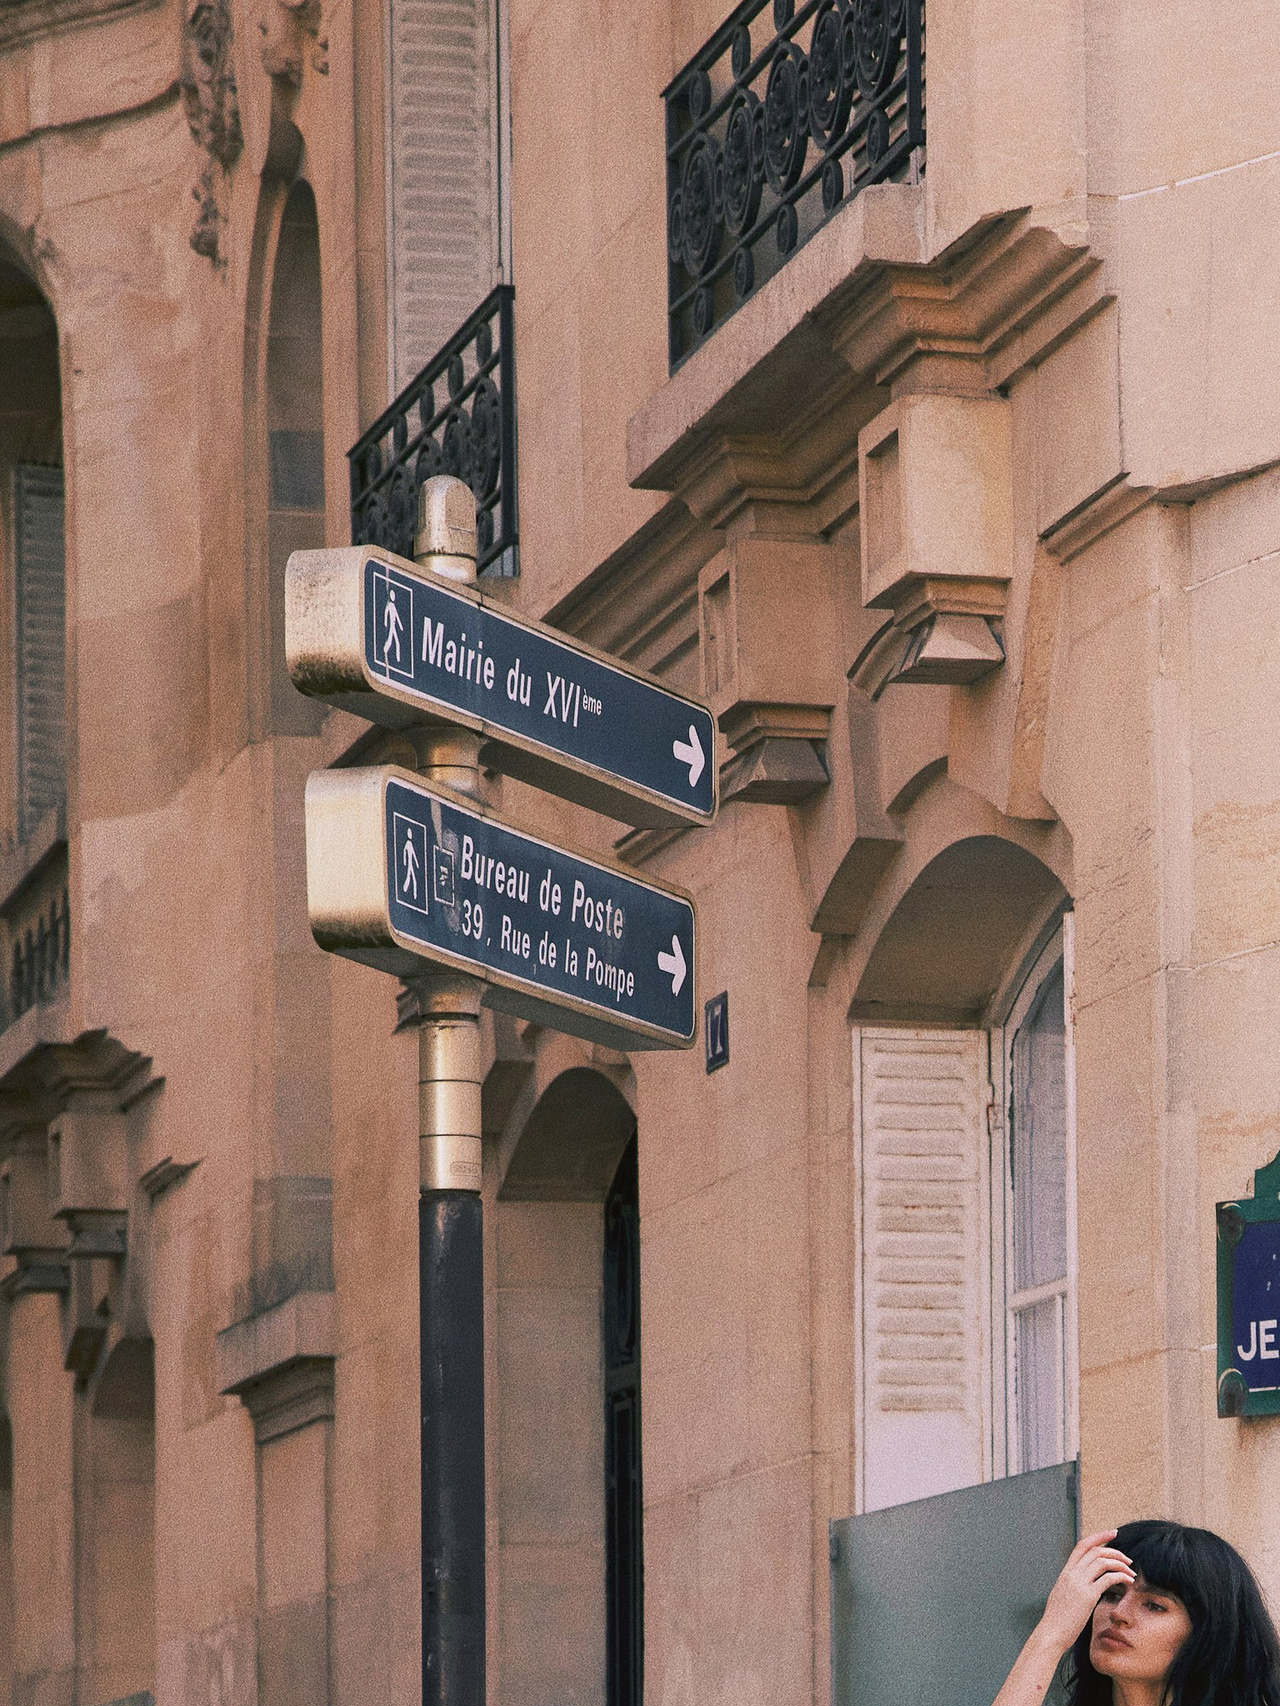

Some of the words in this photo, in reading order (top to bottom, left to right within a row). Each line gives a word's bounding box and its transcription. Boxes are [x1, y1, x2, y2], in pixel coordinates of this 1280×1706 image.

[421, 616, 495, 690] Mairie
[506, 658, 532, 707] du
[460, 833, 530, 903] Bureau
[539, 869, 562, 916] de
[571, 879, 624, 940] Poste
[500, 915, 531, 960] Rue
[538, 930, 557, 969] de
[565, 939, 579, 977] la
[585, 948, 635, 1002] Pompe
